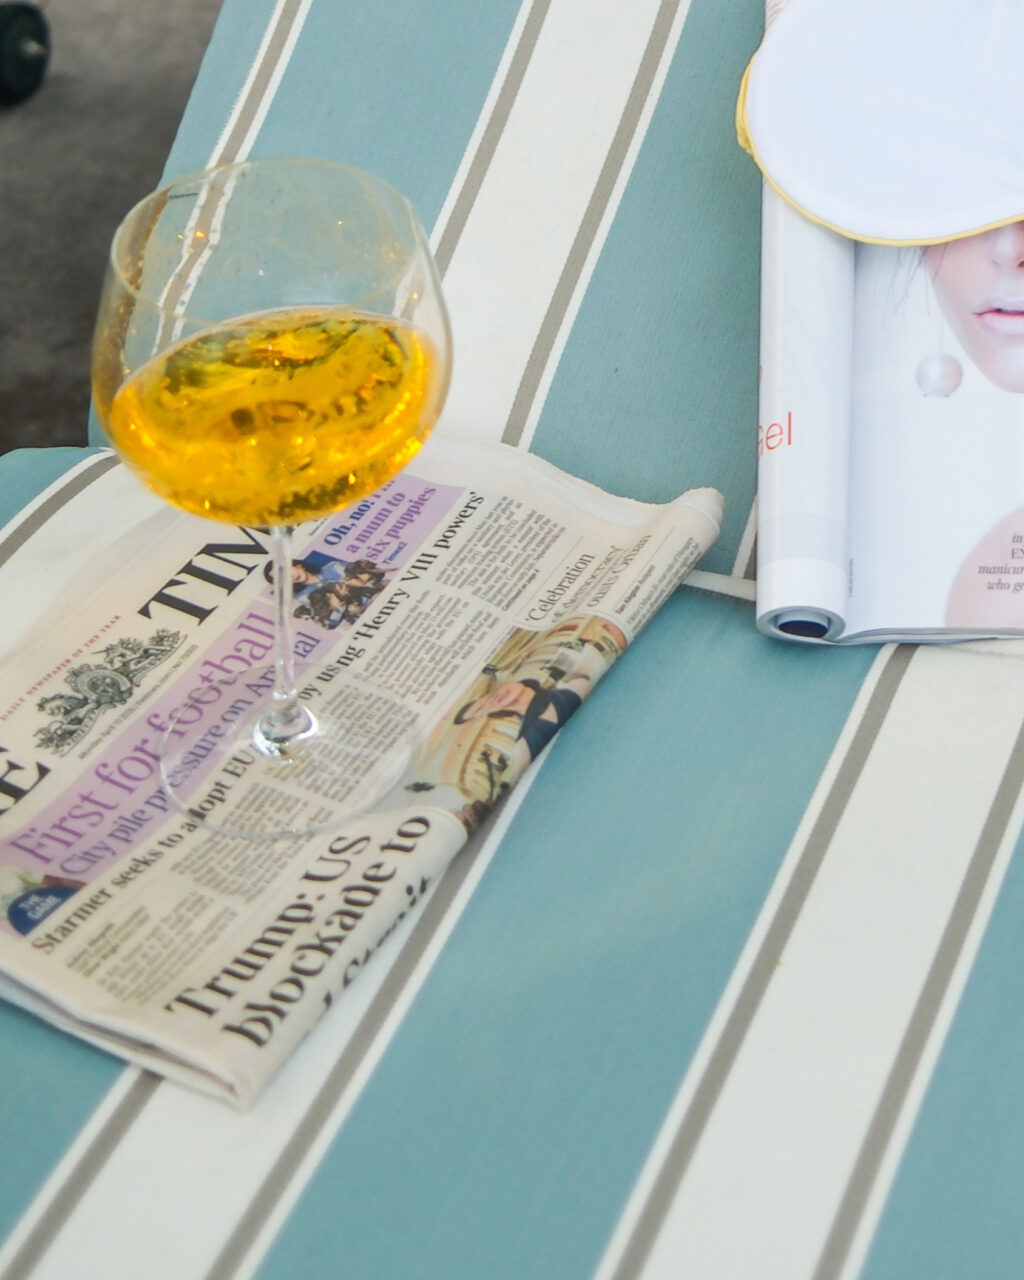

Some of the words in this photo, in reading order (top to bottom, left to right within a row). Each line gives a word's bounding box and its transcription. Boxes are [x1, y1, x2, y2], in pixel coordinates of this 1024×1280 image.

[757, 411, 792, 457] el
[322, 519, 357, 546] Oh,
[348, 498, 375, 520] no!
[352, 509, 391, 544] mum
[362, 536, 391, 562] six
[382, 482, 438, 539] puppies
[384, 489, 407, 507] to
[345, 540, 361, 553] a
[351, 587, 409, 643] ‘Henry
[399, 550, 439, 584] VIII
[432, 489, 485, 549] powers’
[381, 541, 408, 564] Times2
[1011, 532, 1023, 544] in
[524, 549, 596, 623] ‘Celebration
[987, 577, 1011, 591] who
[25, 657, 73, 696] NEWSPAPER
[70, 648, 84, 657] OF
[82, 633, 101, 647] THE
[98, 614, 123, 633] YEAR
[10, 784, 121, 866] First
[91, 734, 169, 795] for
[145, 611, 276, 740] football
[57, 835, 119, 876] City
[103, 807, 152, 842] pile
[143, 724, 228, 811] pressure
[216, 695, 253, 727] on
[29, 887, 113, 955] Starmer
[109, 848, 165, 888] seeks
[155, 832, 184, 847] to
[220, 750, 255, 779] EU
[163, 888, 330, 1018] Trump:
[299, 832, 374, 881] US
[220, 856, 399, 1048] blockade
[377, 811, 434, 854] to
